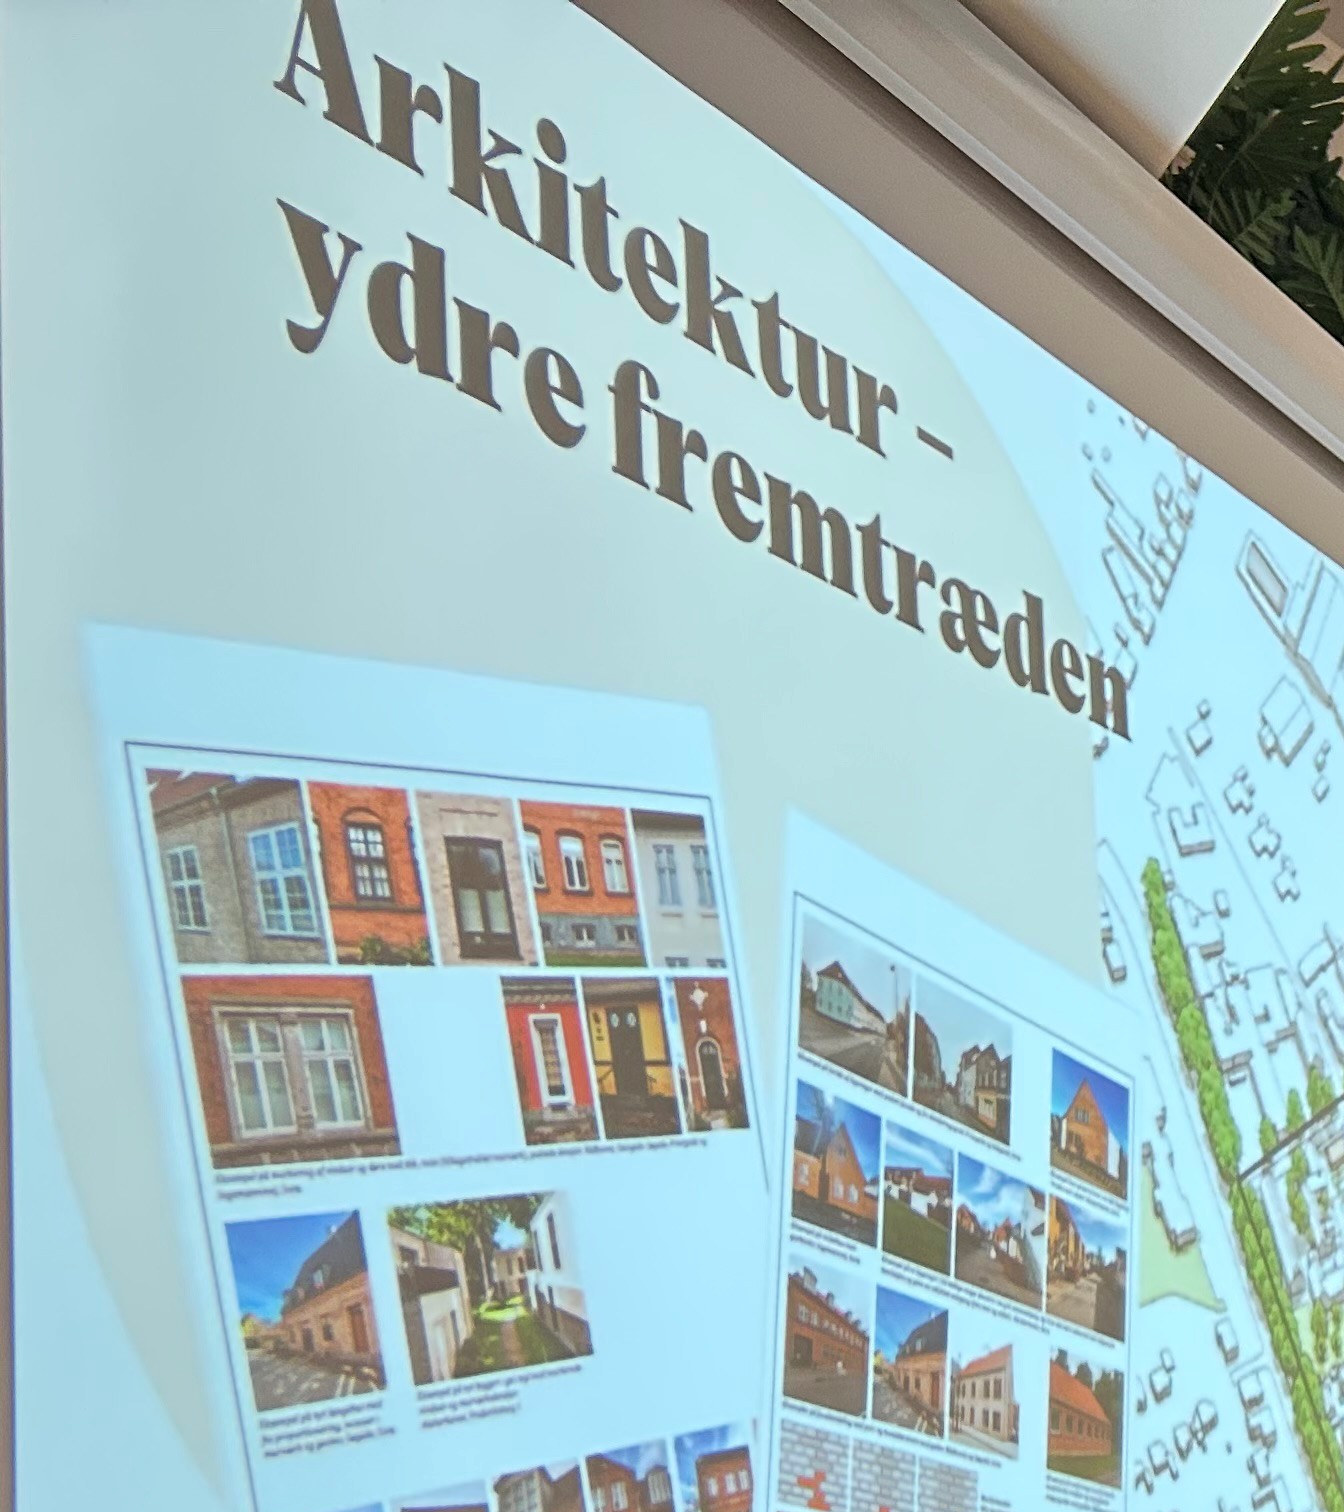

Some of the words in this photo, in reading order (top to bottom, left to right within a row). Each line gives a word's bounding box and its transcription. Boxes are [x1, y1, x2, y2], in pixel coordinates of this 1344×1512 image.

[273, 0, 898, 459] Arkitektur
[275, 198, 588, 449] ydre
[607, 359, 1132, 742] fremtræden
